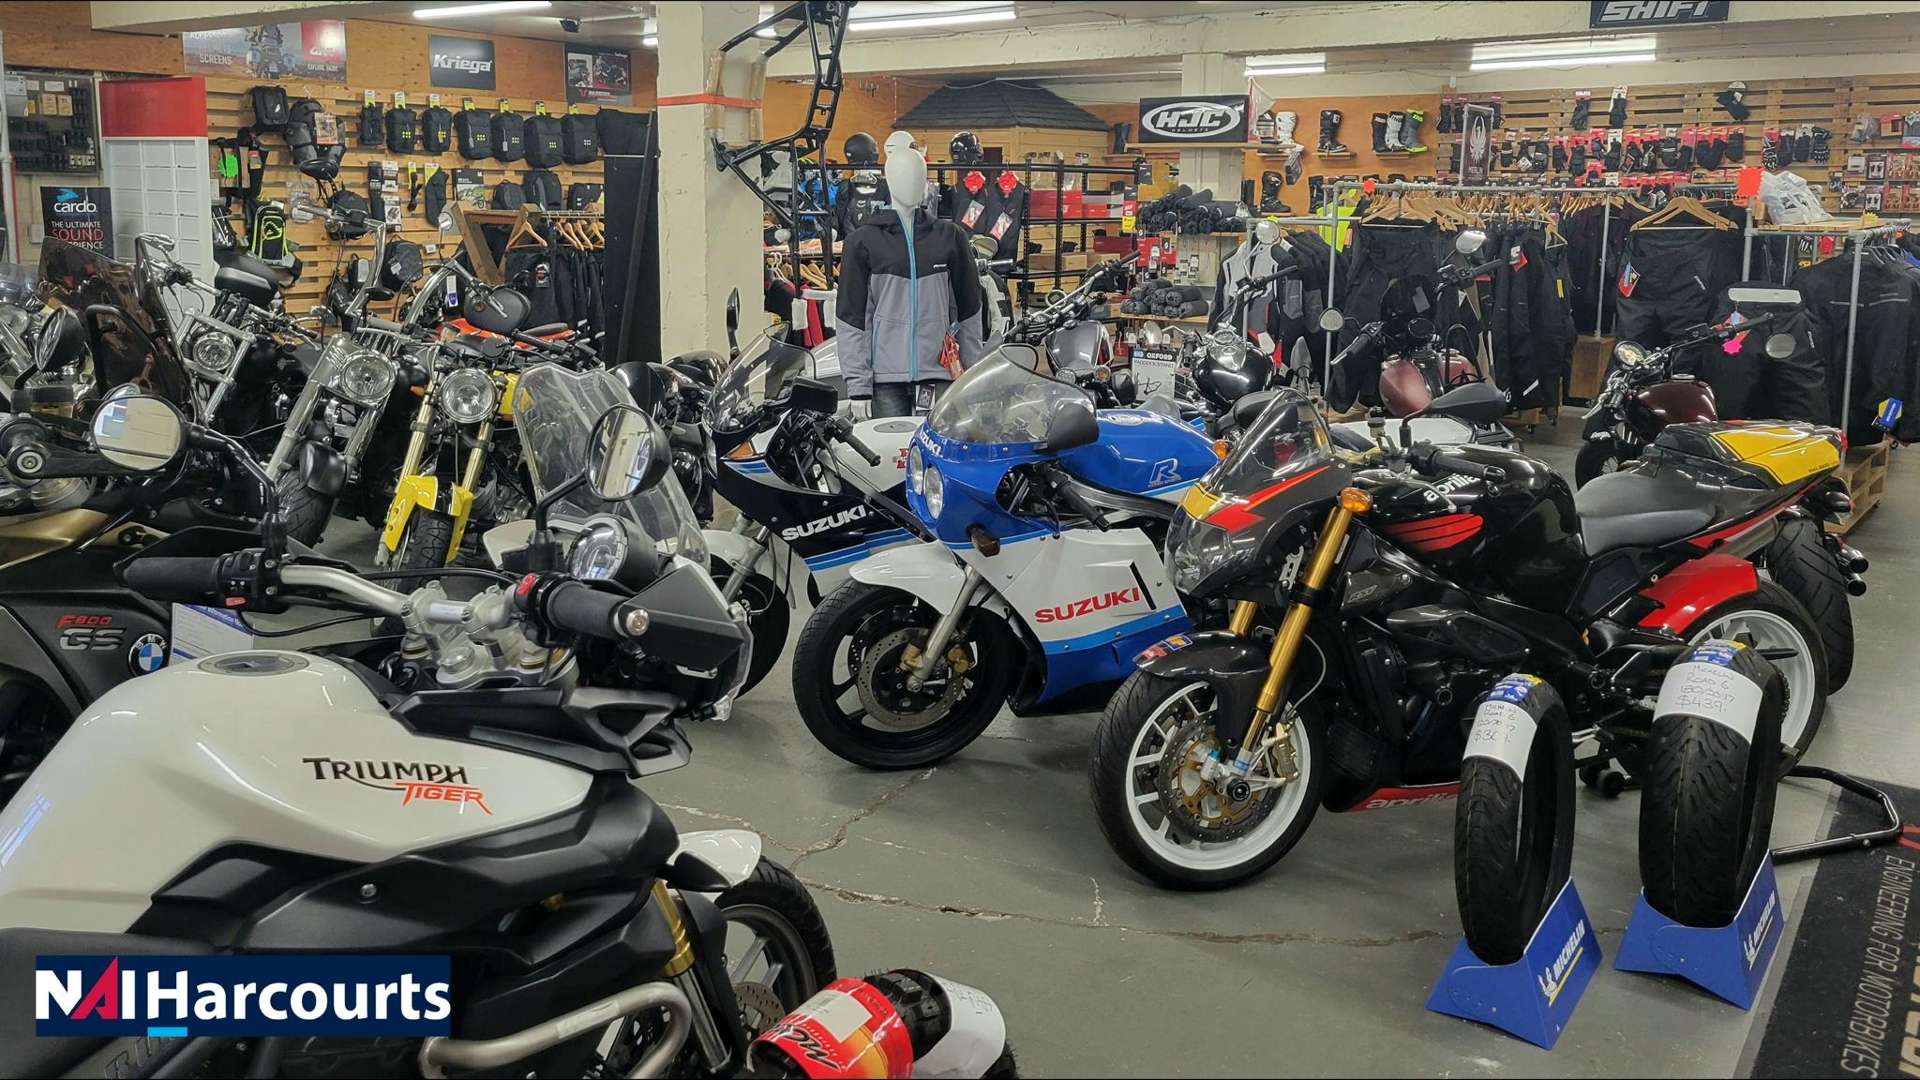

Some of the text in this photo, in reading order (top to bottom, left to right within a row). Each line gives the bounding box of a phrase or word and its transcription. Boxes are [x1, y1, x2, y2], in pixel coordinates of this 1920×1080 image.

[200, 55, 232, 65] SCREENS
[433, 54, 491, 73] Kriega
[1156, 109, 1224, 128] HJC
[54, 200, 97, 213] cardo
[52, 229, 104, 241] SOUND
[1146, 352, 1173, 360] OXFORD
[781, 504, 867, 541] SUZUKI
[1035, 587, 1140, 623] SUZUKI
[56, 614, 112, 629] F800
[60, 628, 126, 650] GS
[135, 634, 168, 650] BMW
[302, 757, 469, 786] TRIUMPH
[396, 782, 493, 816] TIGER
[1870, 854, 1915, 941] ENGINEERING
[1753, 889, 1776, 945] MICHELIN
[1552, 919, 1586, 981] MICHELIN
[1864, 937, 1901, 973] FOR
[1840, 974, 1895, 1079] MOTORBIKES
